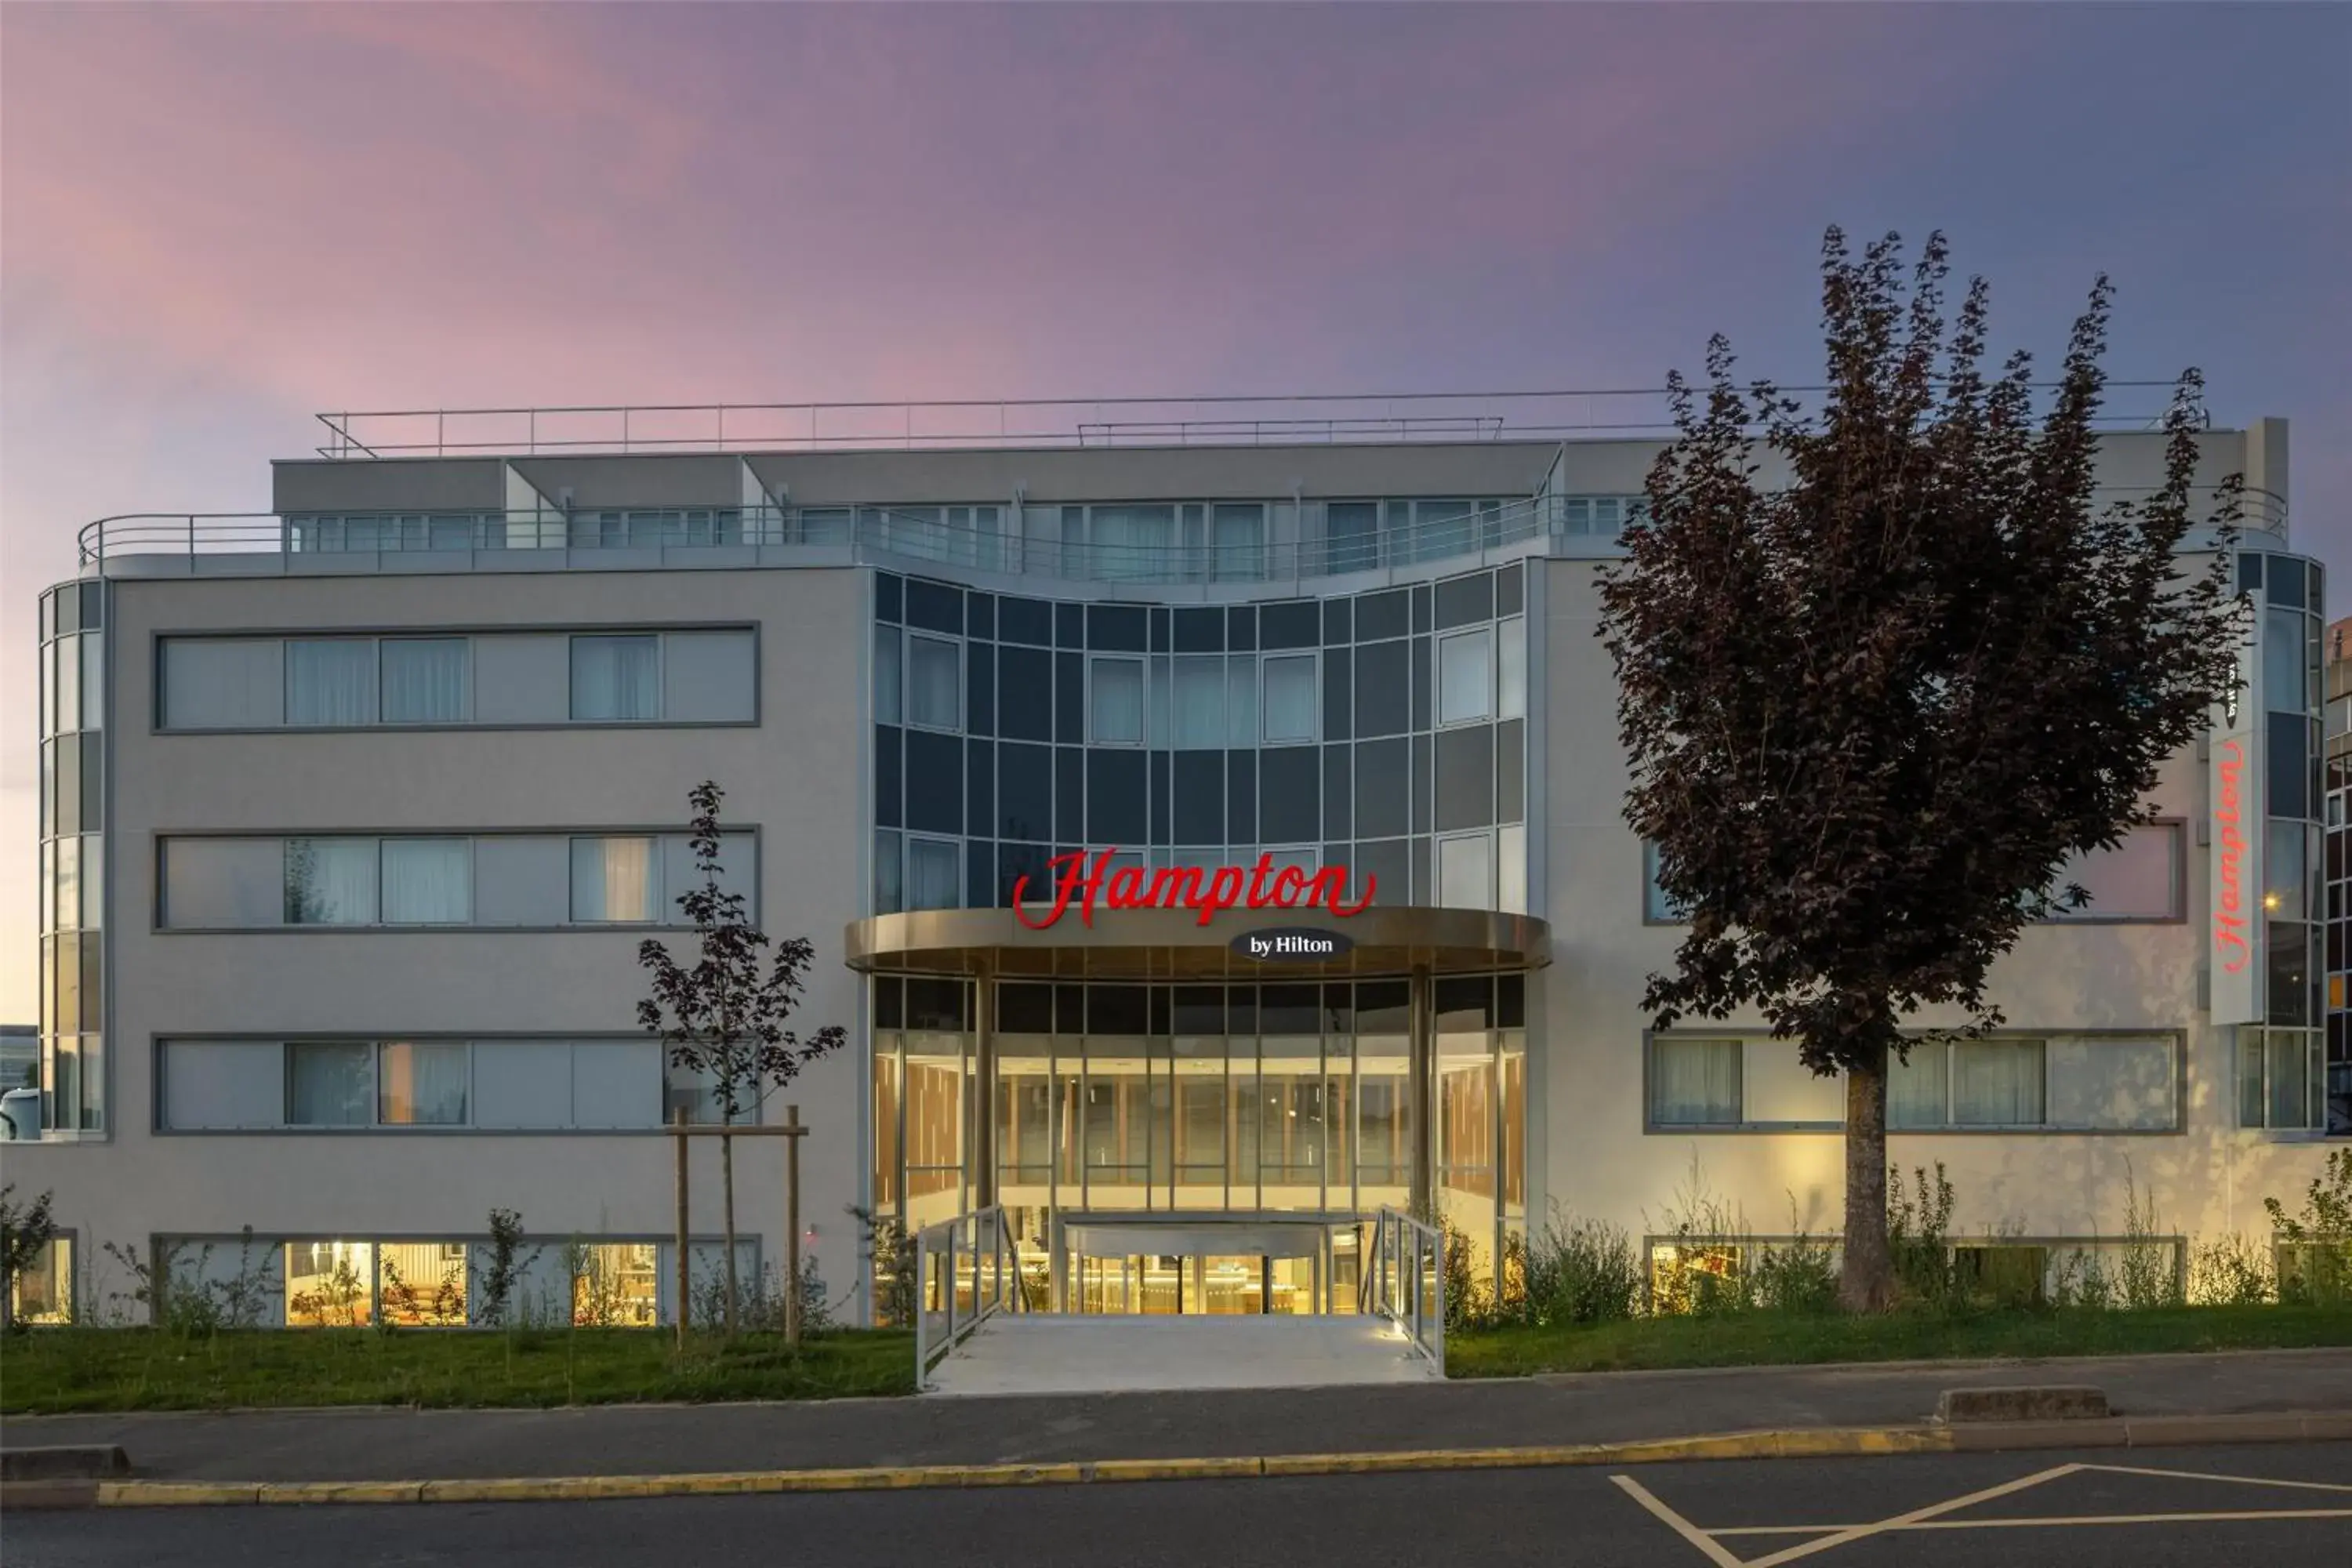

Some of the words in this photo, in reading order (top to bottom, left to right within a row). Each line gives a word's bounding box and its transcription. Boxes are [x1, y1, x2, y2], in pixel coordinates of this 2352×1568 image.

[1012, 846, 1376, 930] Hampton
[2213, 741, 2251, 973] Hampton
[1250, 937, 1272, 956] by
[1276, 936, 1333, 953] Hilton
